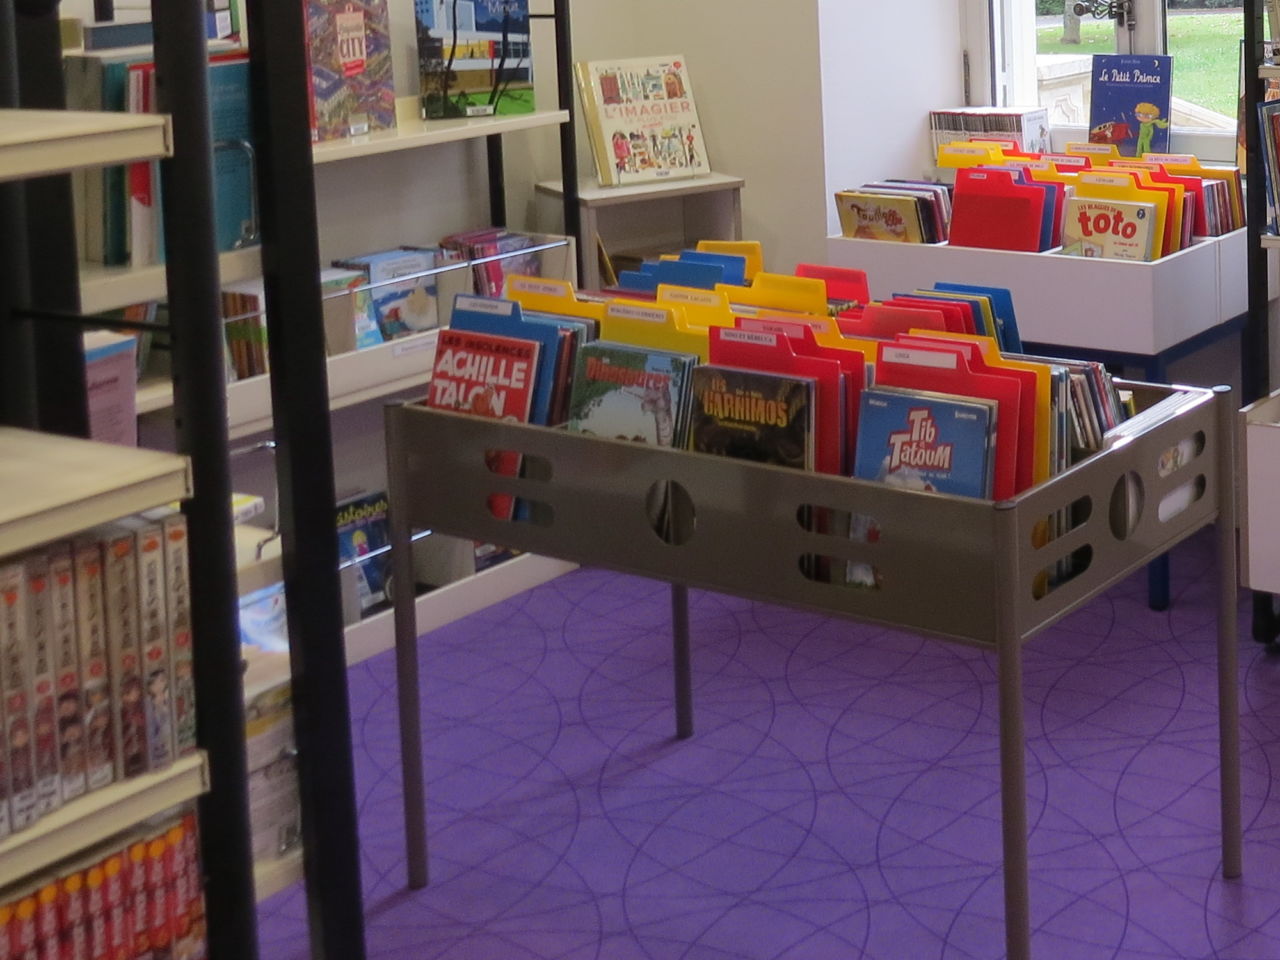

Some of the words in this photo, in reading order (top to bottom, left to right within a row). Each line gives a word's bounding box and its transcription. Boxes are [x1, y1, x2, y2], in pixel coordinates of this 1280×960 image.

[1099, 68, 1109, 82] Le
[1111, 68, 1131, 82] Petit
[1133, 68, 1161, 84] Prince
[604, 101, 691, 120] L'IMAGIER
[1088, 204, 1110, 212] BLAGUES
[1077, 209, 1137, 239] toto
[442, 335, 461, 345] LES
[465, 340, 533, 358] INSOLENCES
[436, 349, 528, 389] ACHILLE
[433, 378, 507, 417] TALON
[908, 409, 936, 443] Tib
